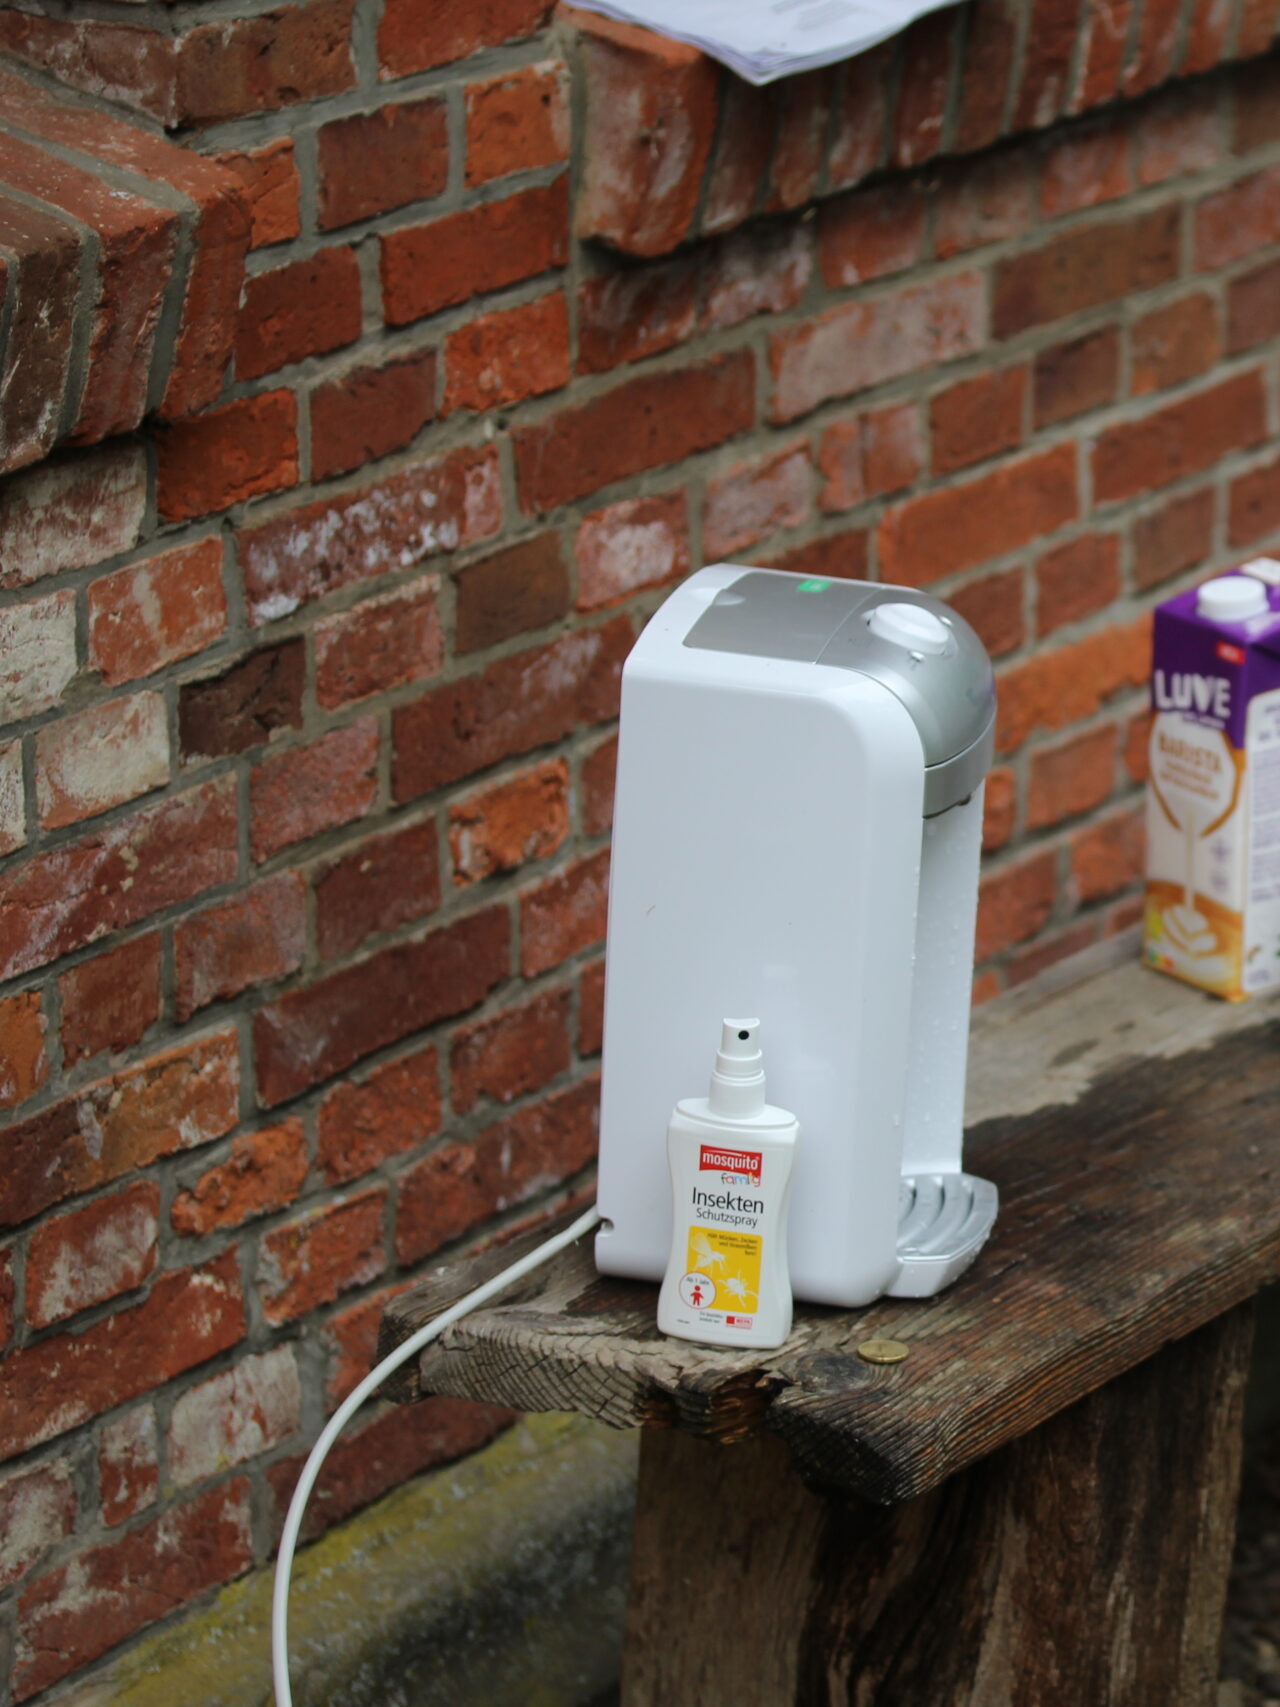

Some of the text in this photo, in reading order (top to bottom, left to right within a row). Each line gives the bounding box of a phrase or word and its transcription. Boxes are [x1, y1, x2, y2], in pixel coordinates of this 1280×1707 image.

[1154, 669, 1231, 719] LUVE
[702, 1152, 759, 1170] mosquito
[721, 1171, 761, 1187] family
[692, 1187, 764, 1214] Insekten
[696, 1207, 758, 1229] Schutzspray
